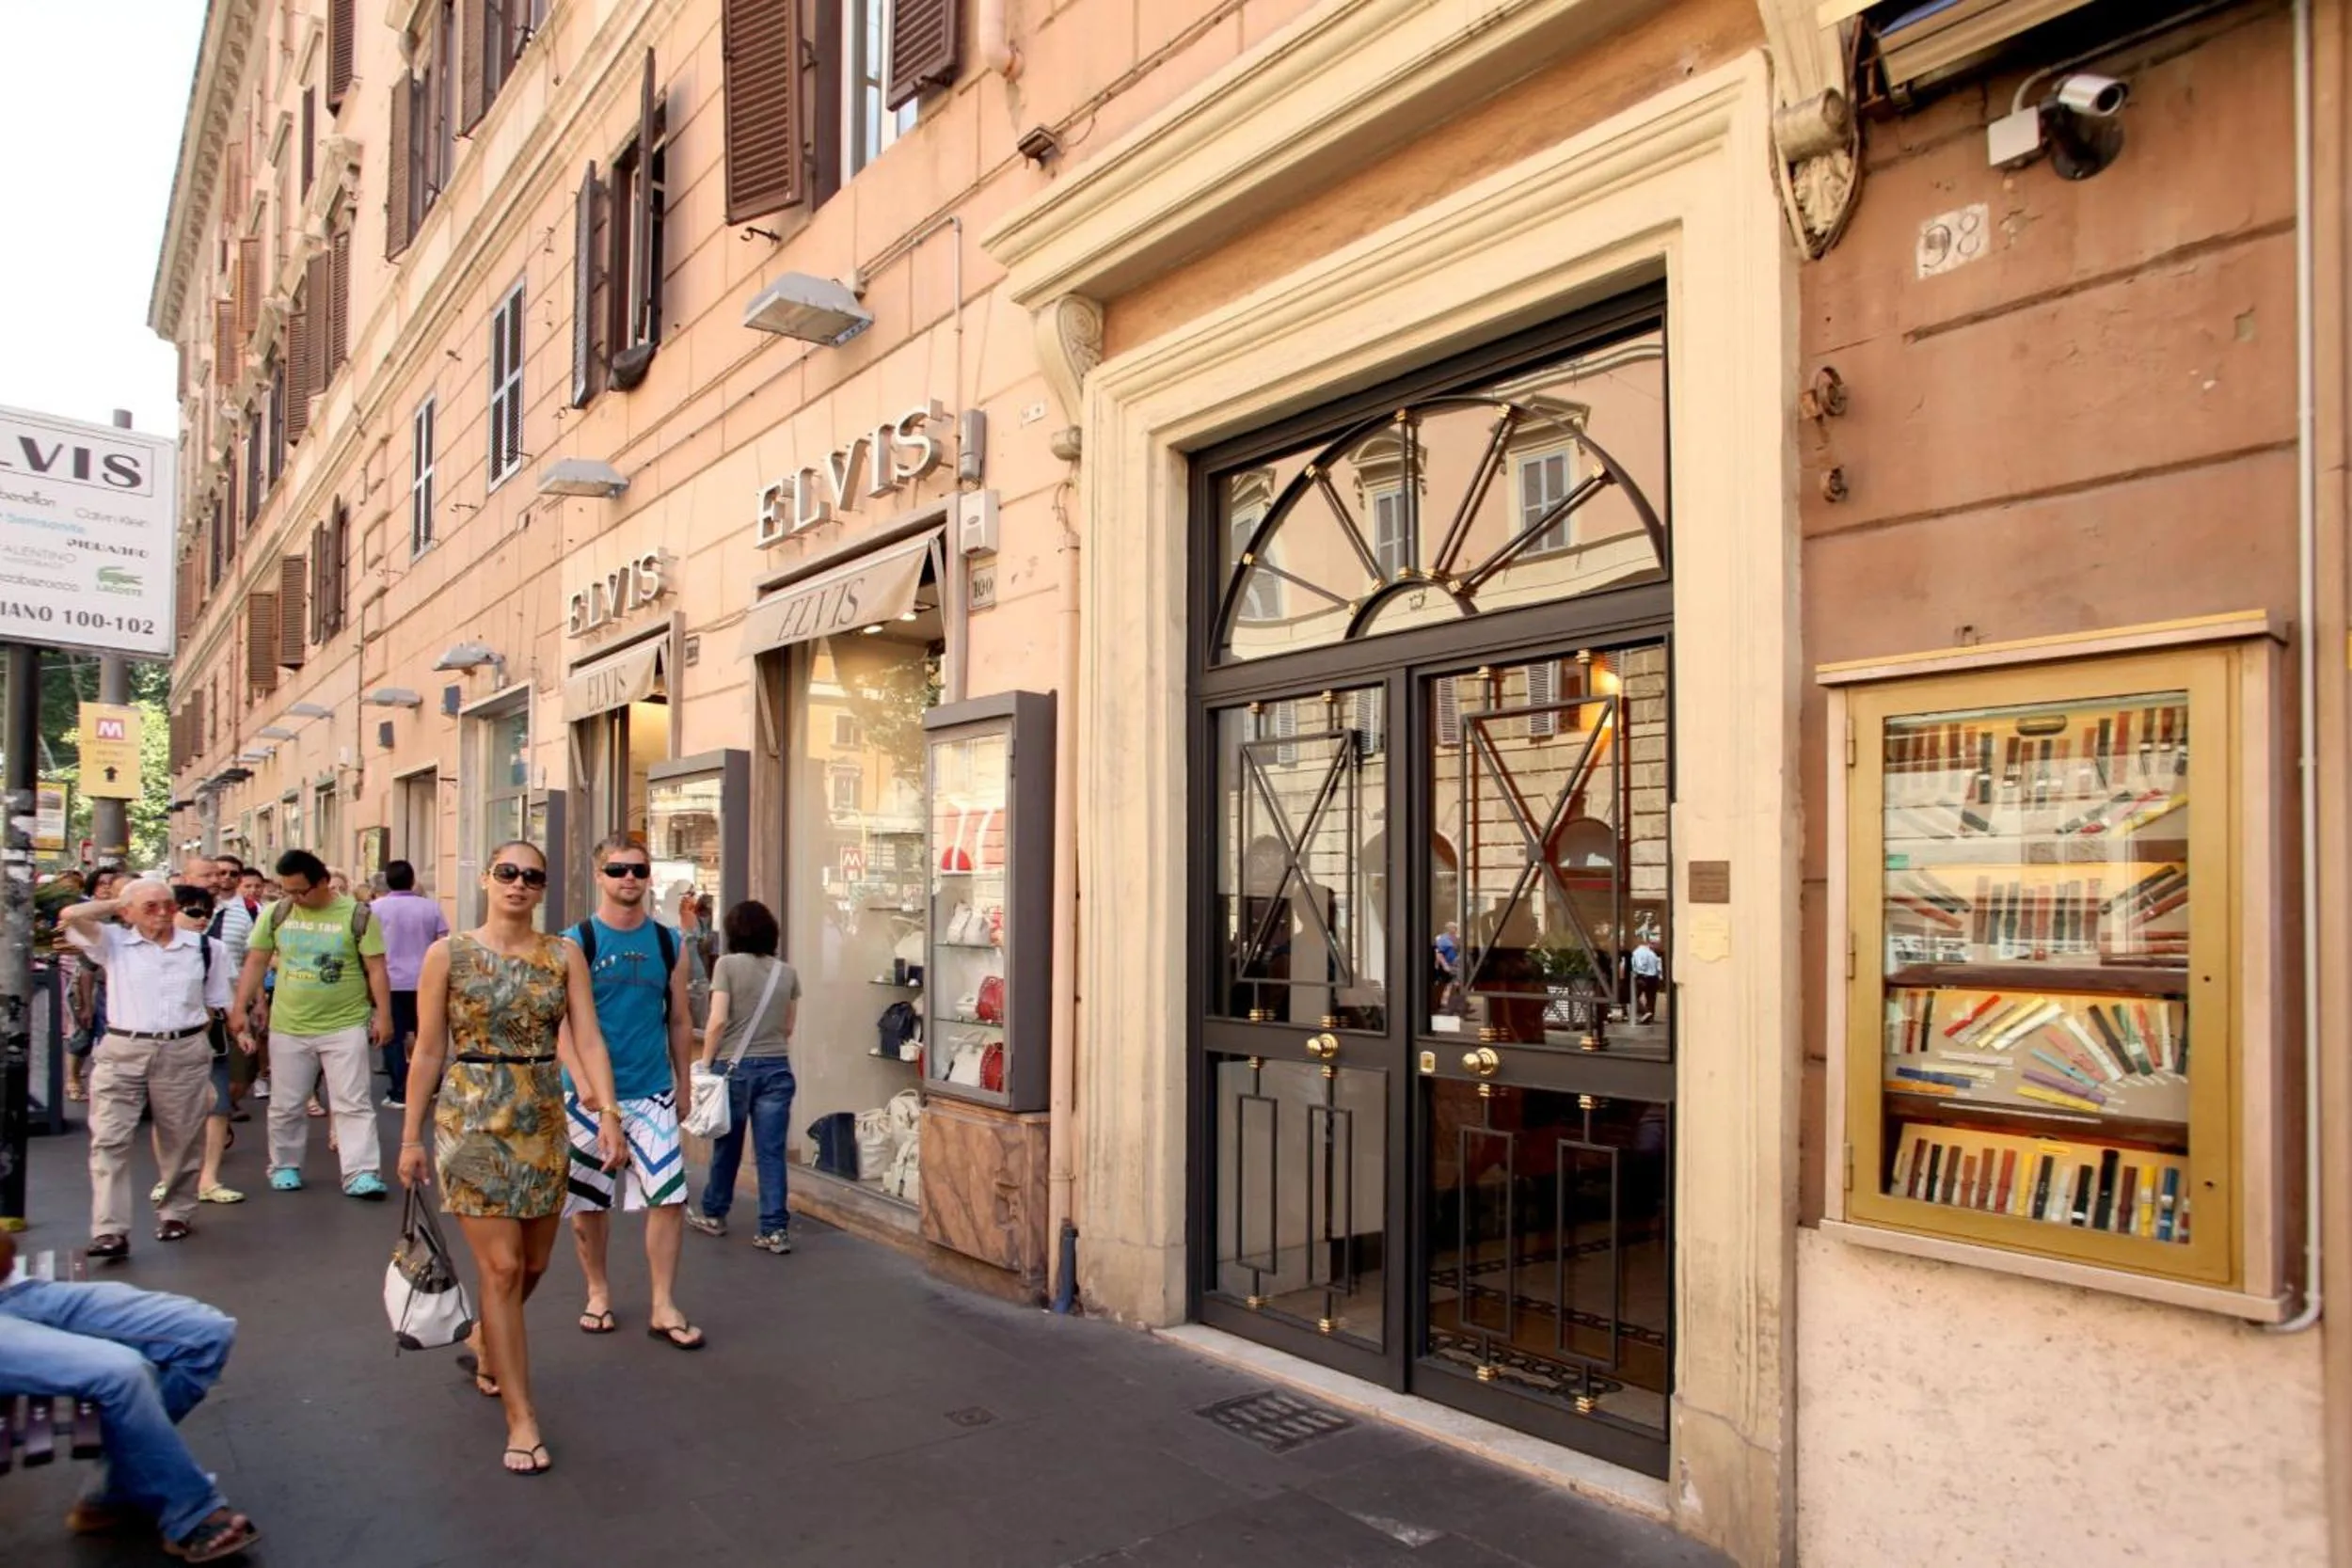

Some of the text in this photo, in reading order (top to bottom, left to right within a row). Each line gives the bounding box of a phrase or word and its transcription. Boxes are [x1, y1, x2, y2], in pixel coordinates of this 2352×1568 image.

[1922, 212, 1981, 269] 98
[0, 436, 142, 488] VIS
[755, 402, 944, 549] ELVIS
[567, 549, 669, 639] ELVIS
[777, 577, 866, 641] ELVIS
[974, 576, 993, 599] 100
[62, 610, 154, 635] 100-102
[587, 664, 628, 712] ELVIS
[98, 721, 122, 737] M
